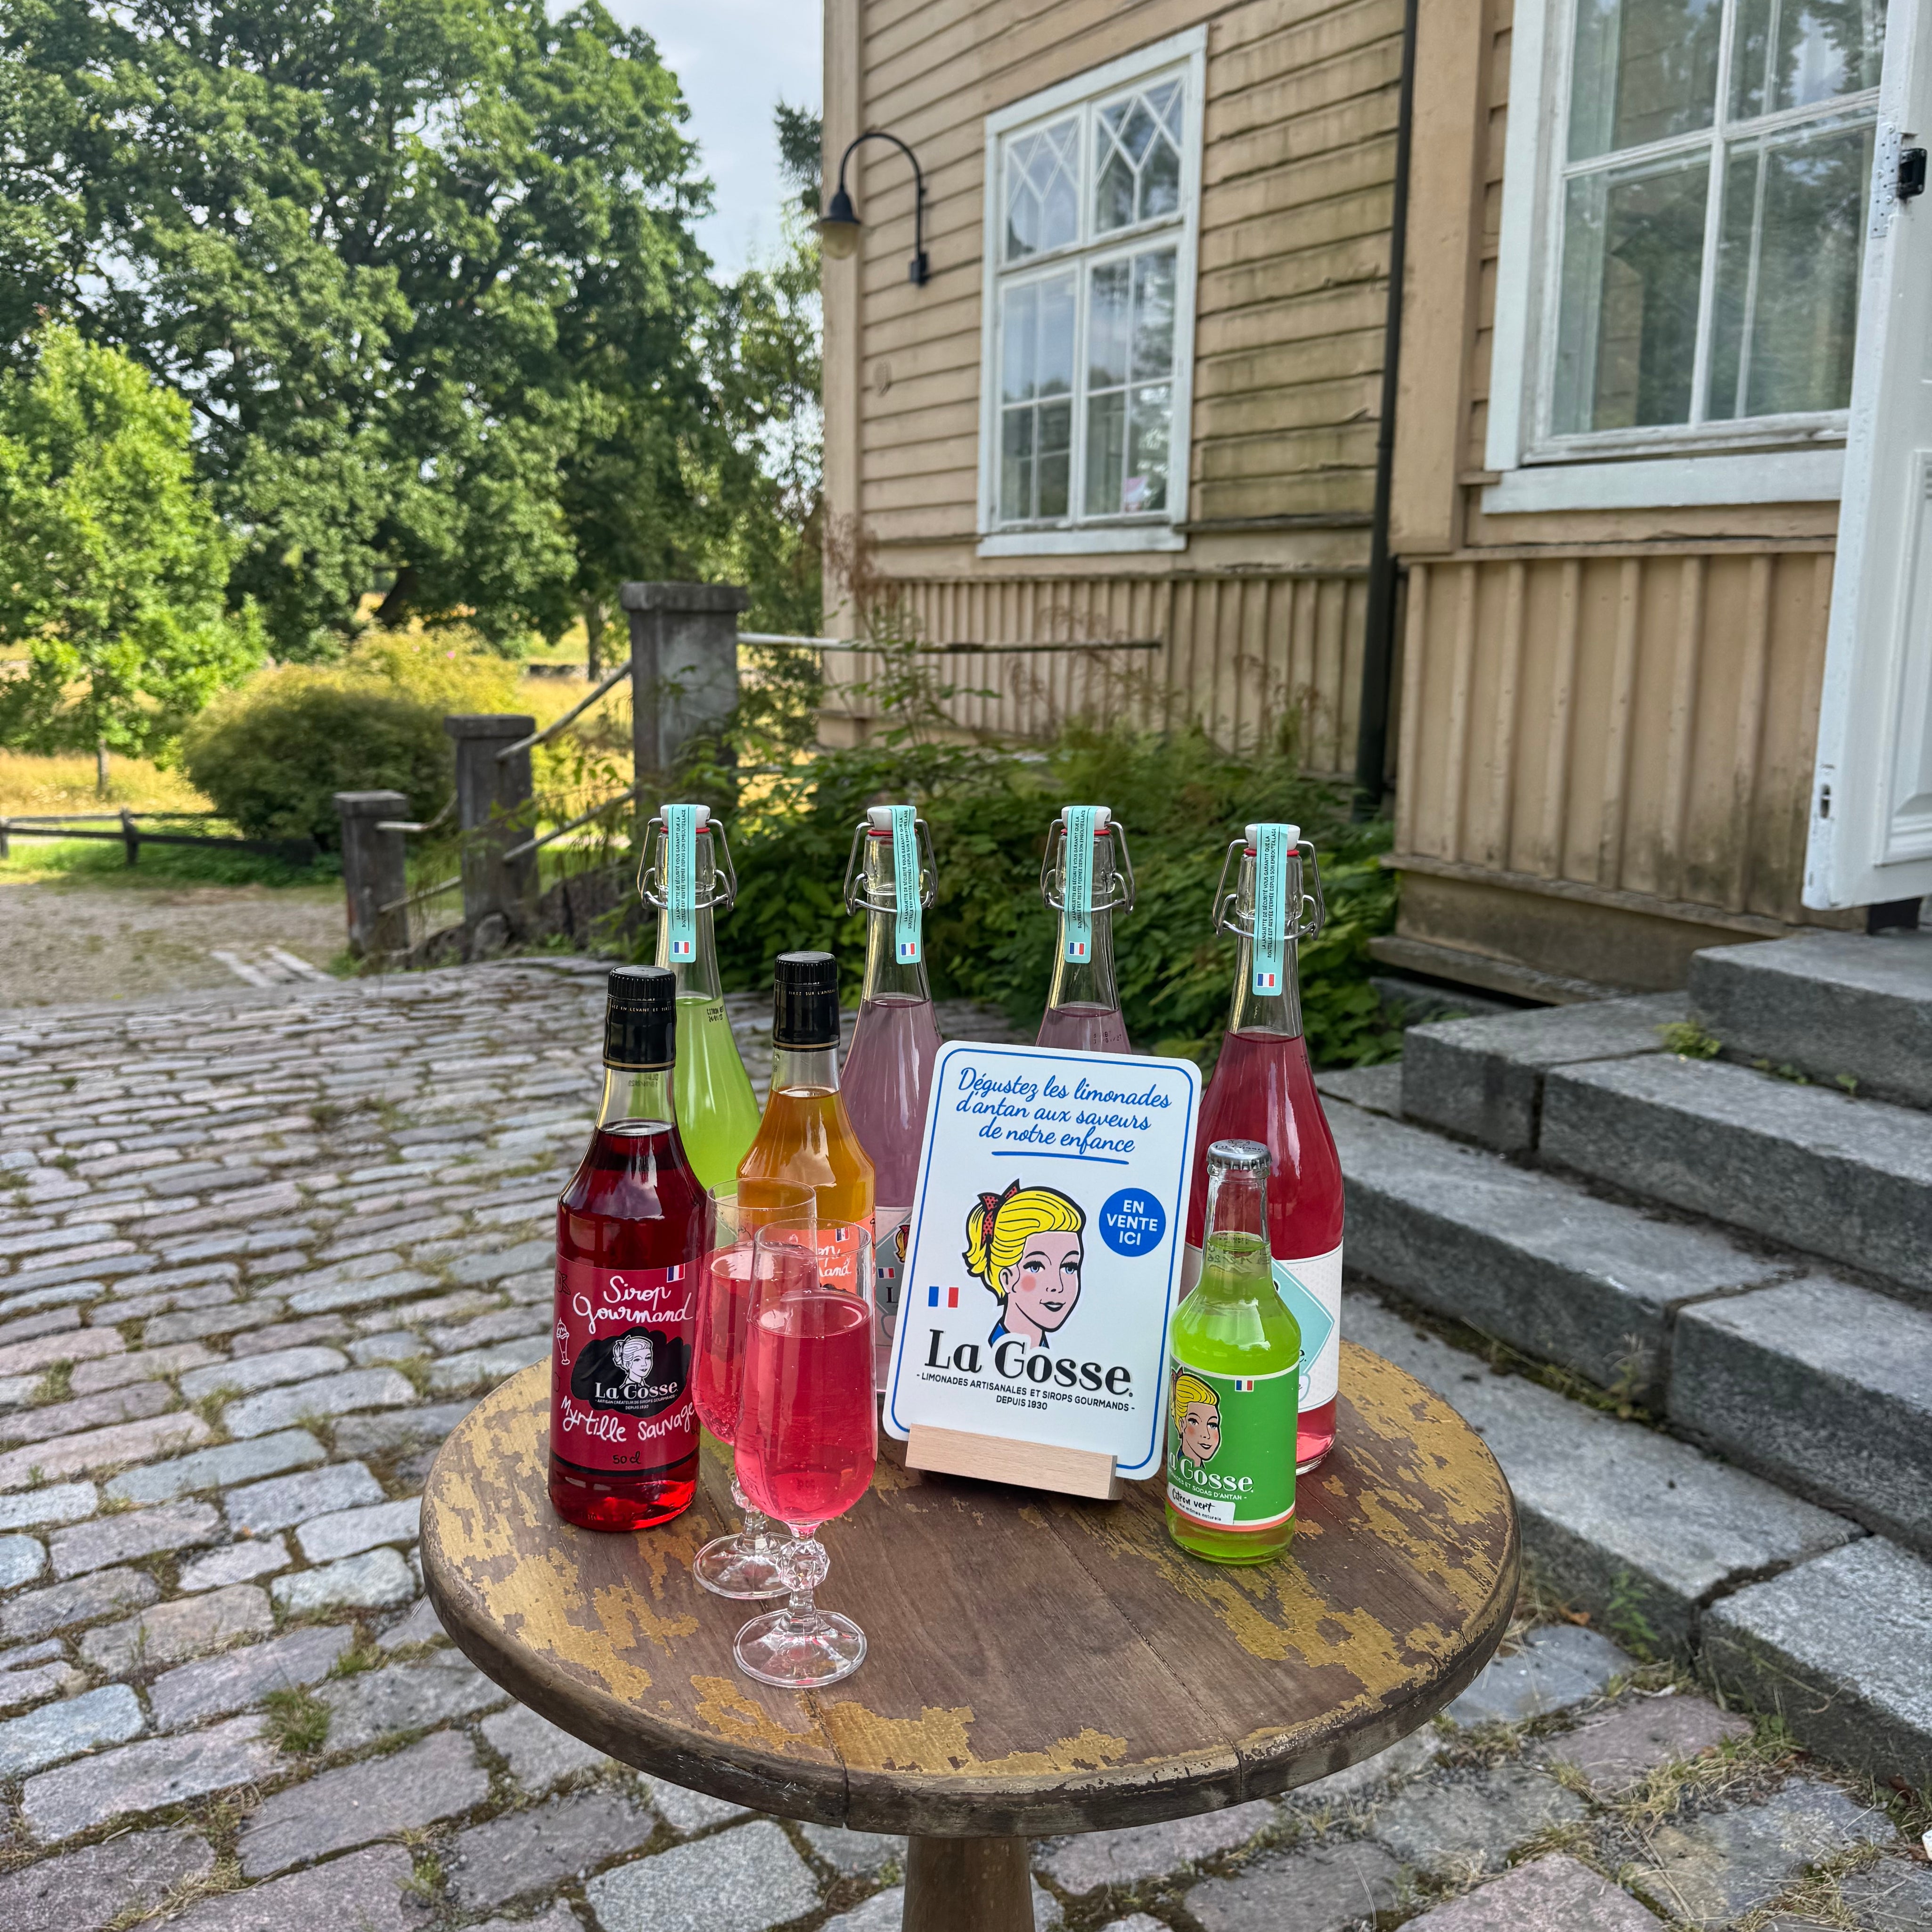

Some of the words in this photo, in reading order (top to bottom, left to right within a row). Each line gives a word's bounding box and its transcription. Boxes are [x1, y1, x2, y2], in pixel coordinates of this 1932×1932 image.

[958, 1067, 1039, 1102] Dégustez
[1043, 1075, 1070, 1099] les
[1073, 1077, 1172, 1108] limonades
[956, 1091, 1030, 1118] d'antan
[1033, 1107, 1071, 1122] aux
[1076, 1110, 1152, 1130] saveurs
[979, 1116, 1003, 1139] de
[1006, 1123, 1056, 1145] notre
[1060, 1126, 1136, 1155] enfance
[1123, 1199, 1144, 1214] EN
[1106, 1213, 1158, 1232] VENTE
[1119, 1231, 1141, 1245] ICI
[603, 1275, 671, 1311] Sirop
[573, 1292, 694, 1334] Gourmand
[925, 1329, 982, 1373] La
[595, 1382, 619, 1399] La
[921, 1372, 968, 1386] LIMONADES
[970, 1380, 1027, 1396] ARTISANALES
[1030, 1389, 1041, 1398] ET
[1042, 1391, 1072, 1403] SIROPS
[1074, 1396, 1130, 1411] GOURMANDS
[996, 1395, 1026, 1407] DEPUIS
[1027, 1400, 1048, 1410] 1930
[561, 1395, 627, 1442] Myrtille
[638, 1402, 695, 1441] Sauvage
[613, 1454, 628, 1464] 50
[628, 1450, 641, 1465] cl
[1172, 1488, 1191, 1505] Citron
[1193, 1500, 1216, 1513] vert
[1192, 1485, 1212, 1496] SODAS
[1214, 1492, 1242, 1500] D'ANTAN
